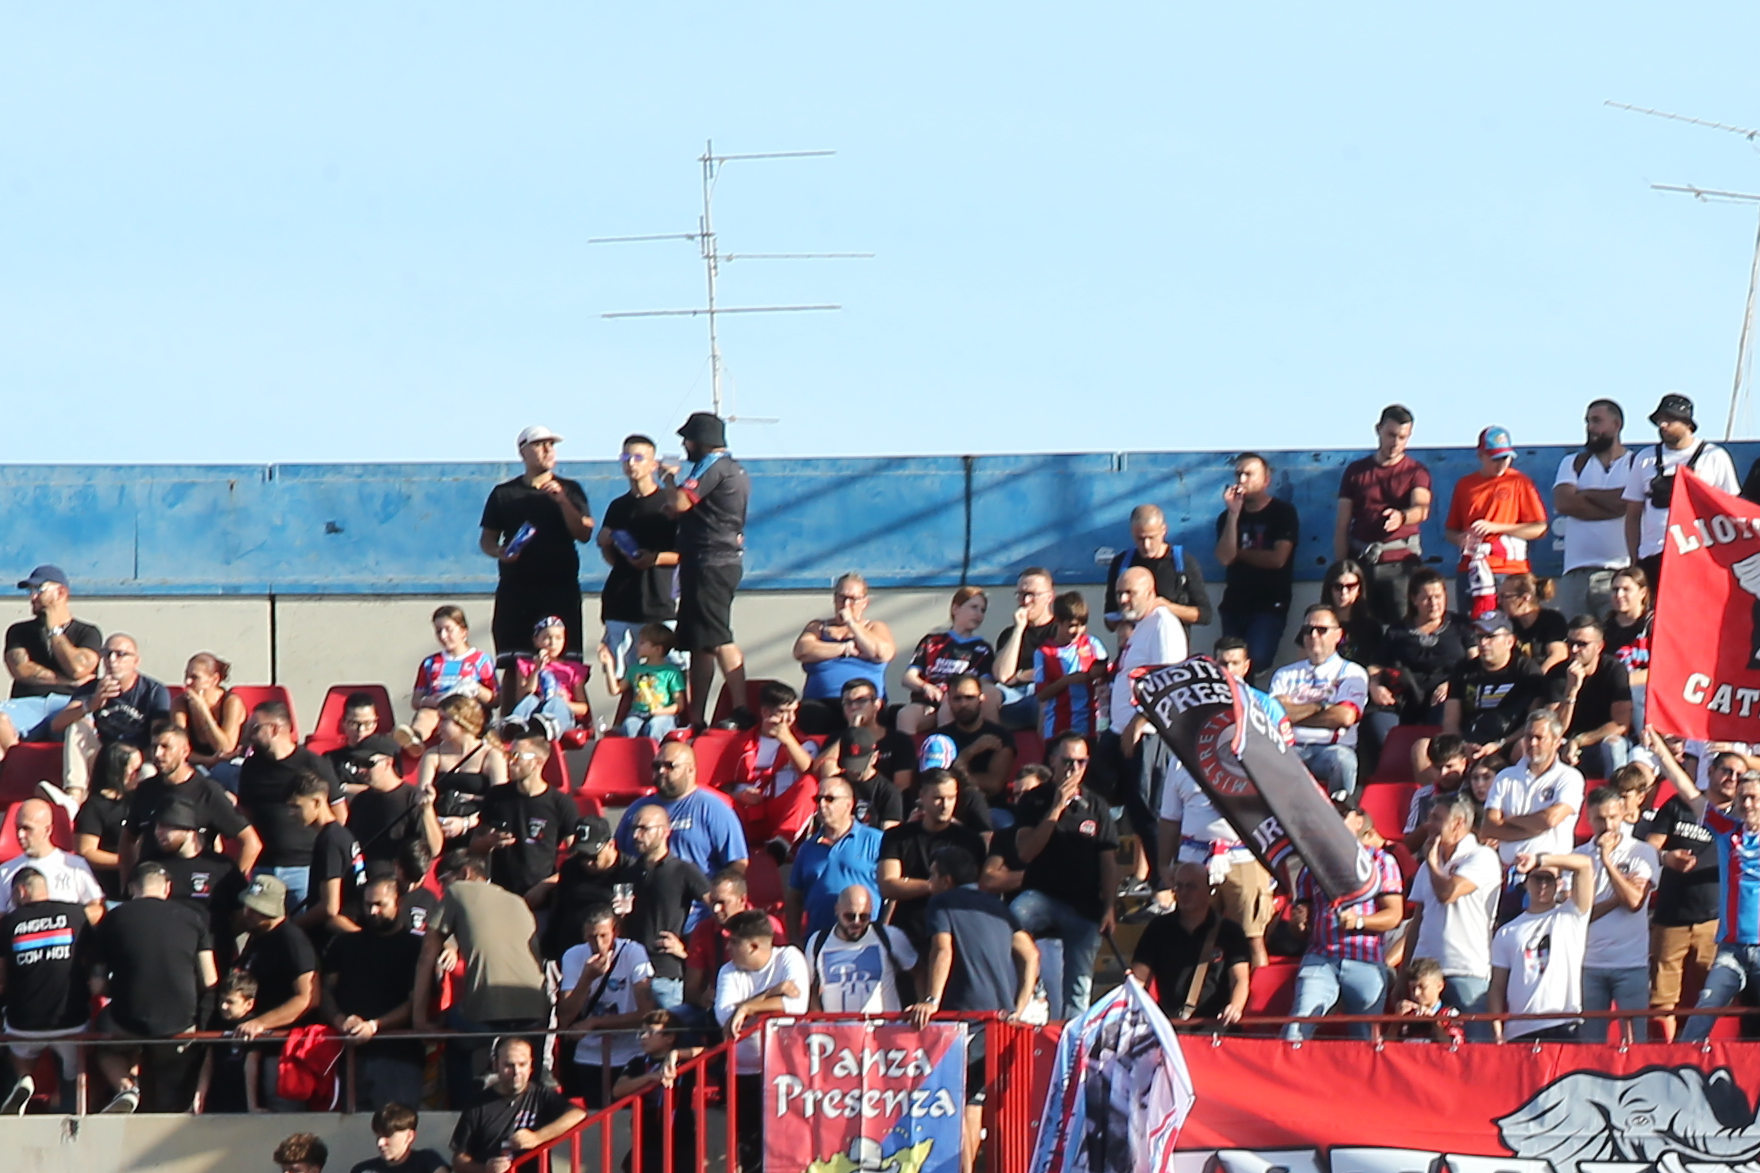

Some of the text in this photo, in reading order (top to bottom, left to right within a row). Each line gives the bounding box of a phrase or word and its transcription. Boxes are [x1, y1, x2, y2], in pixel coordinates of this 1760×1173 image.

[14, 915, 67, 935] ANGELO
[804, 1033, 933, 1079] Panza
[771, 1073, 957, 1119] Presenza
